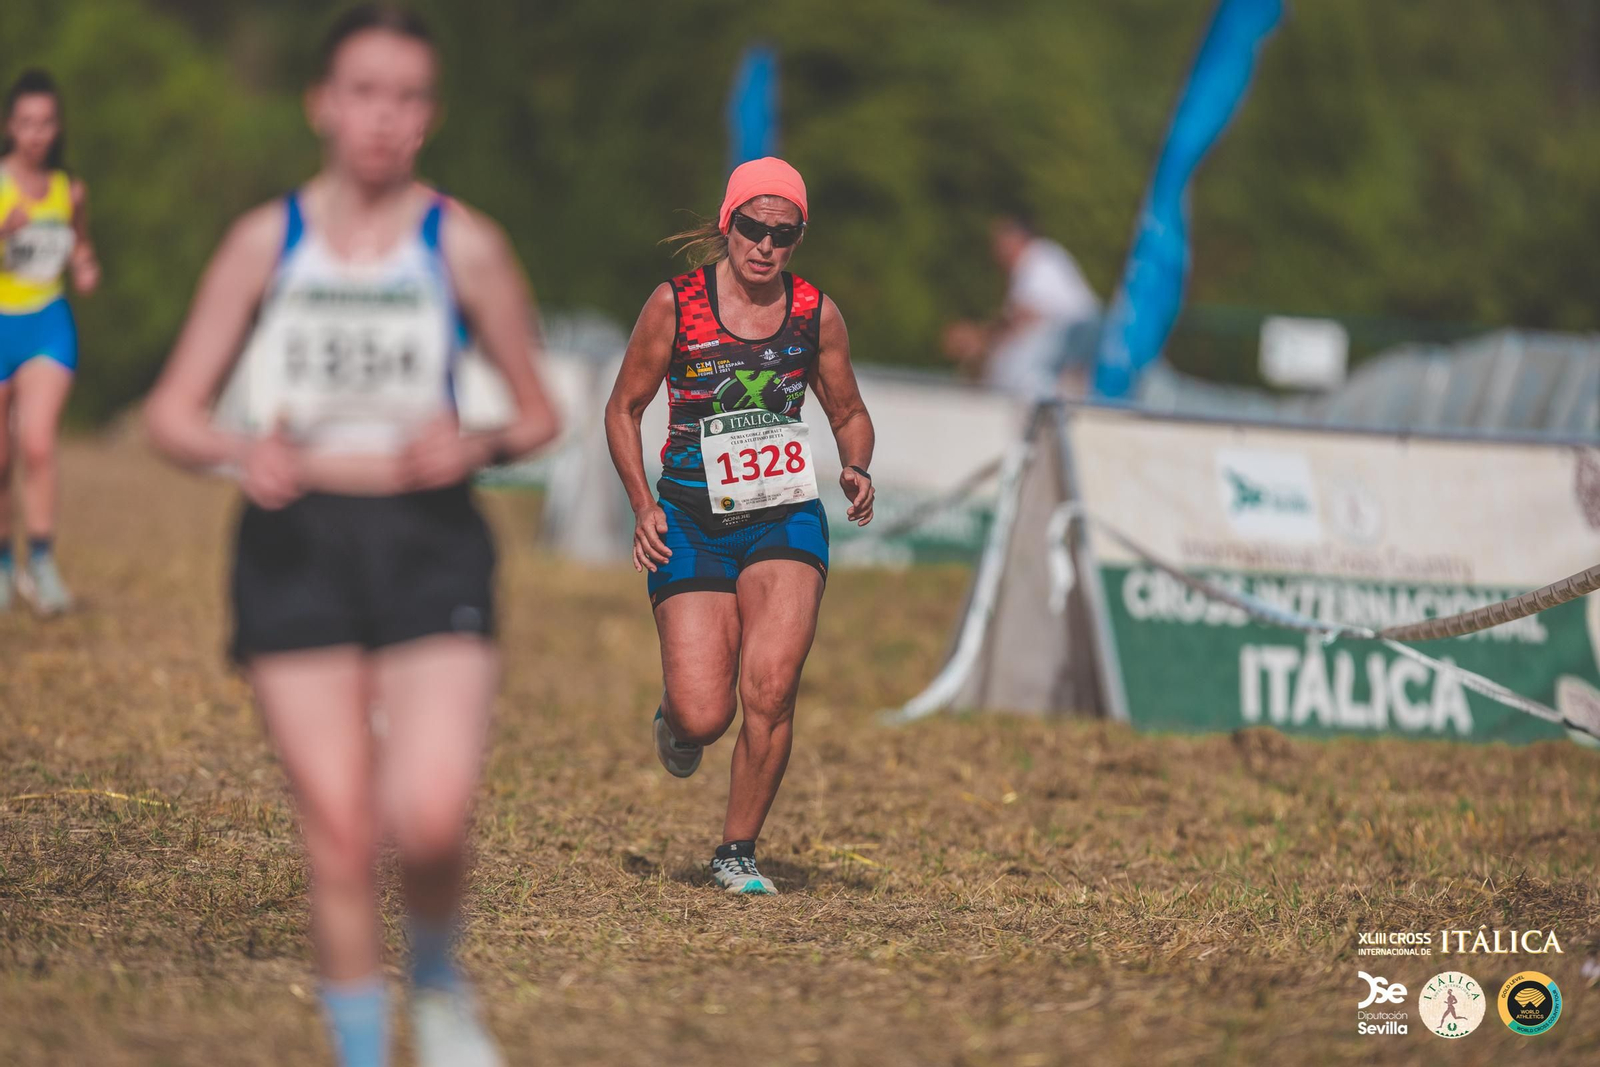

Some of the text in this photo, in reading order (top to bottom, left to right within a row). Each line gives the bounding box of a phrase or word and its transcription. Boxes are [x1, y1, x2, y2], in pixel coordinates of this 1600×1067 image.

[725, 361, 745, 369] ESPAÑA
[730, 413, 780, 429] ITÁLICA
[716, 441, 806, 485] 1328
[1239, 634, 1475, 736] ITÁLICA
